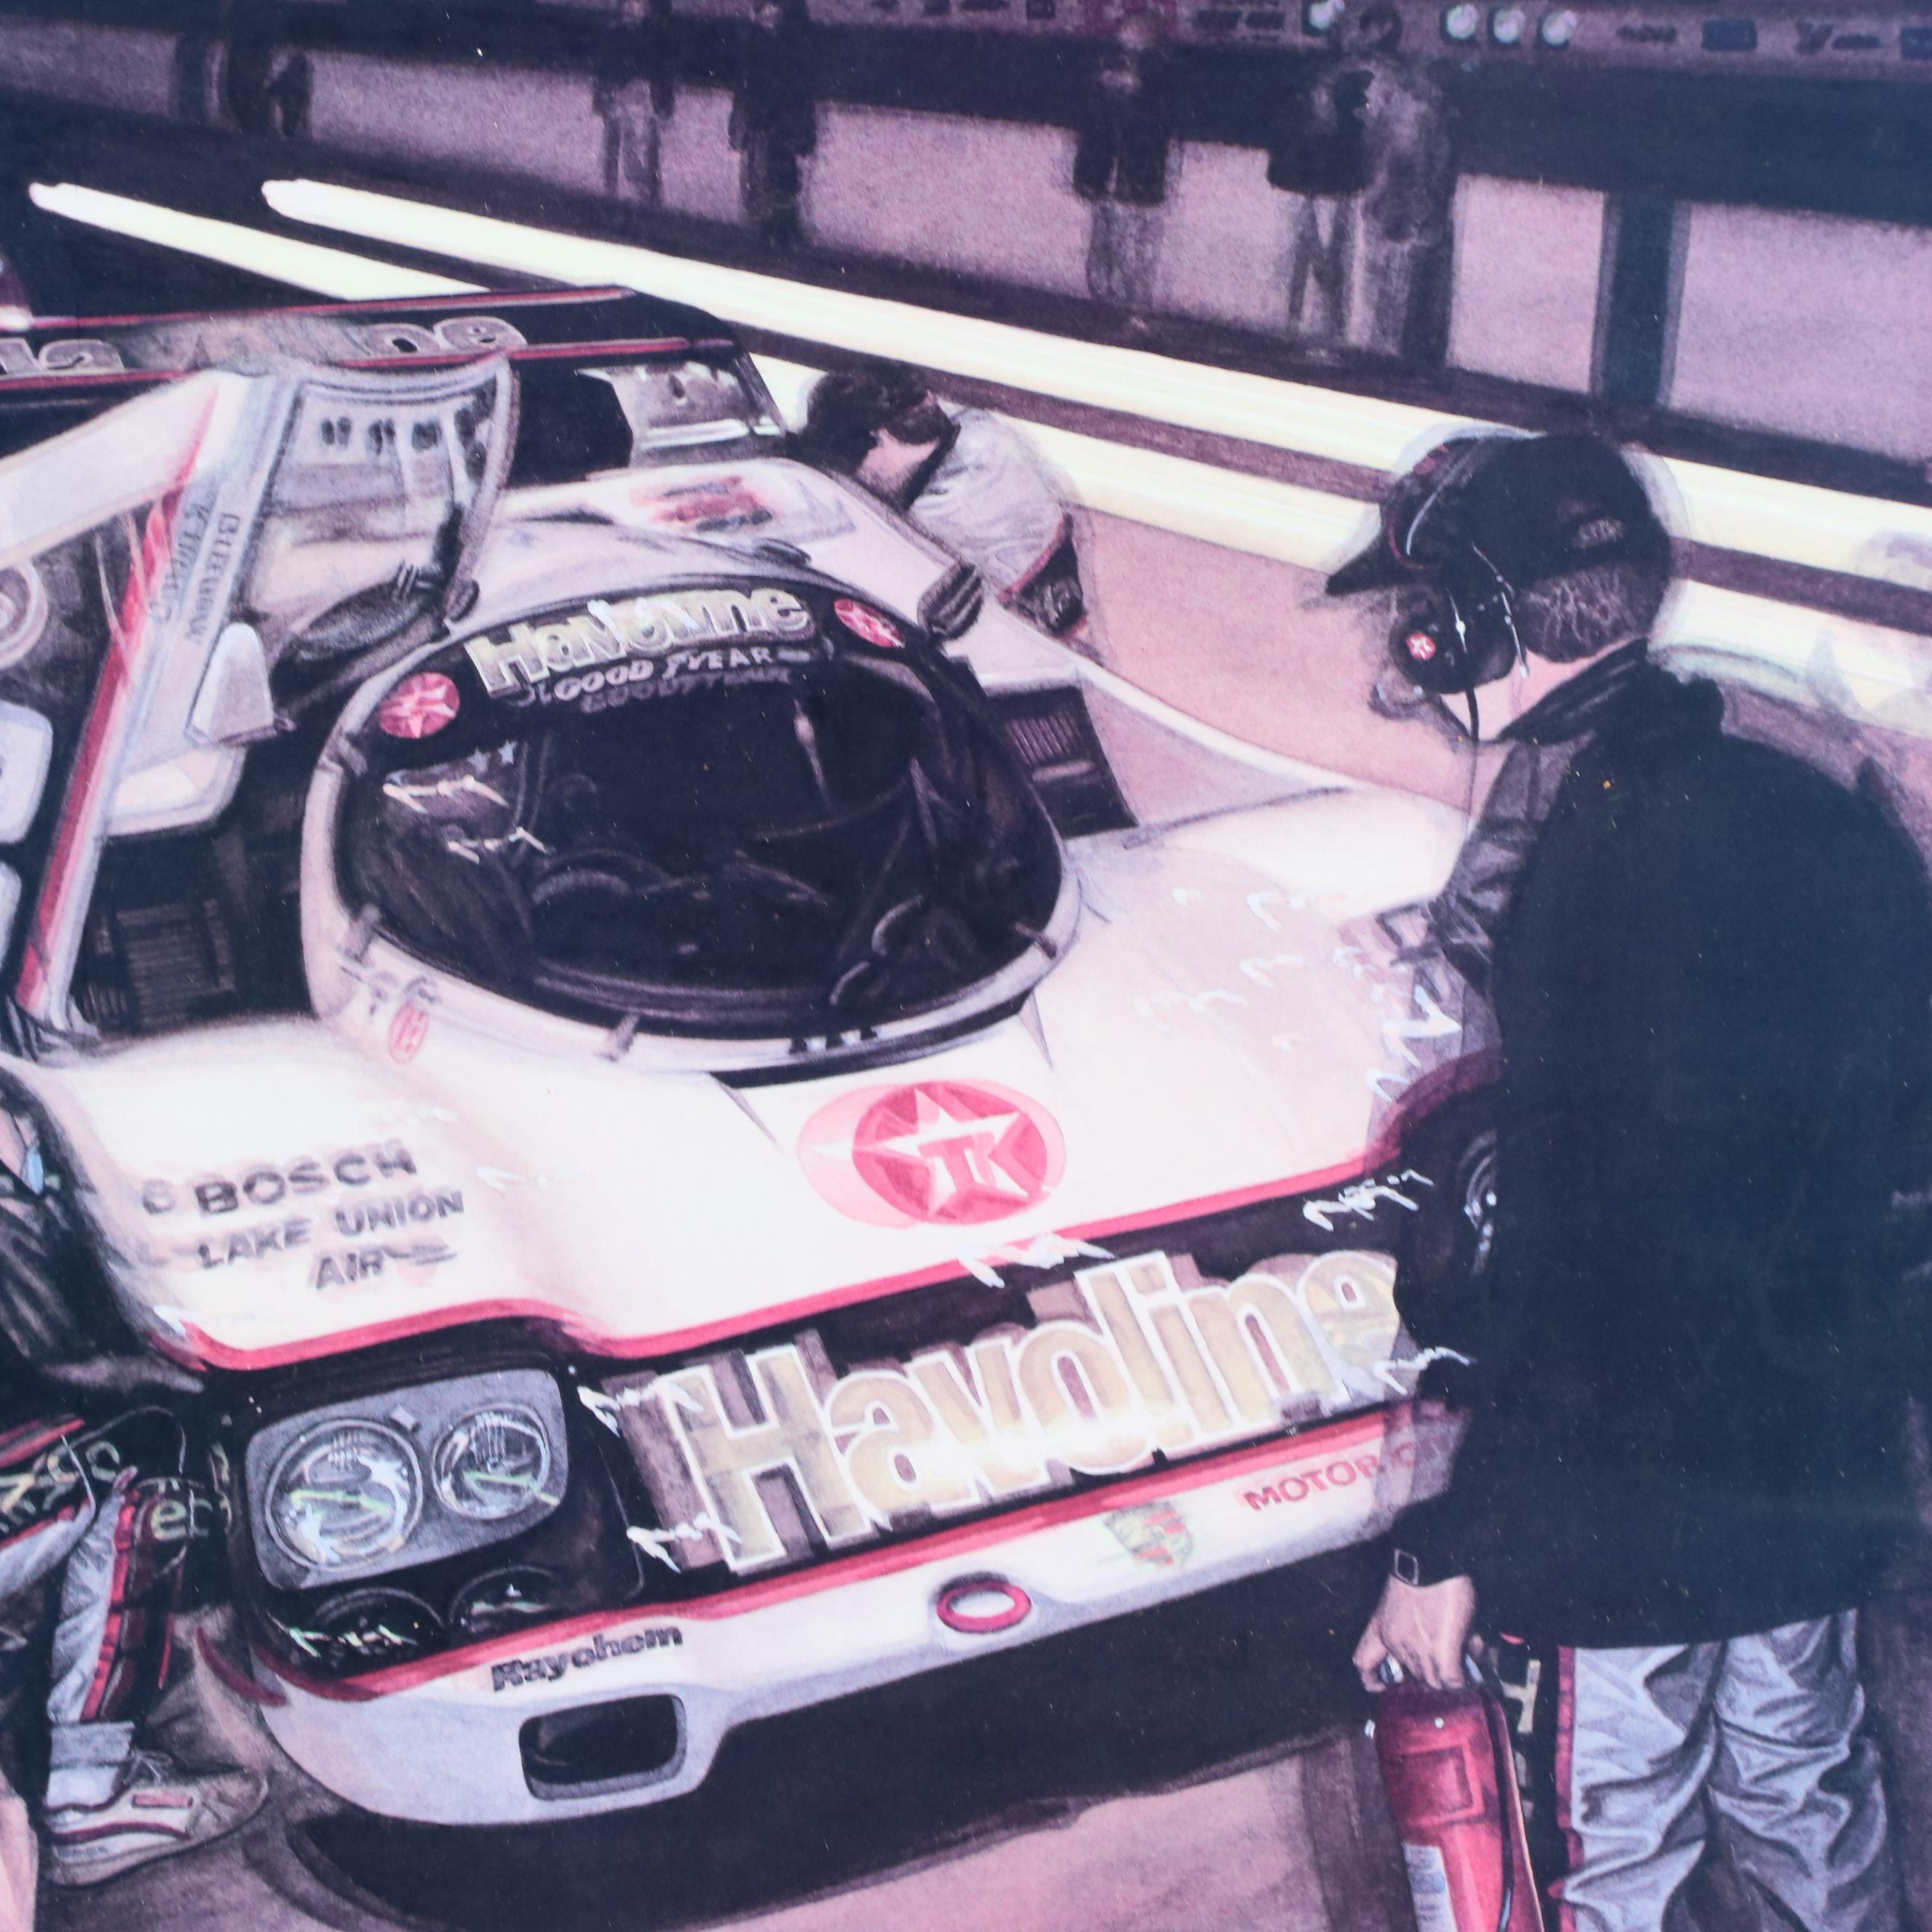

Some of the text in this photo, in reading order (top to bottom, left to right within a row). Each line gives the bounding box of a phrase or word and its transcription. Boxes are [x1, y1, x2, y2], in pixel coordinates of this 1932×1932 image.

[194, 1141, 418, 1213] BOSCH
[198, 1188, 465, 1269] LAKE UNION
[658, 1248, 1399, 1575] Havoline
